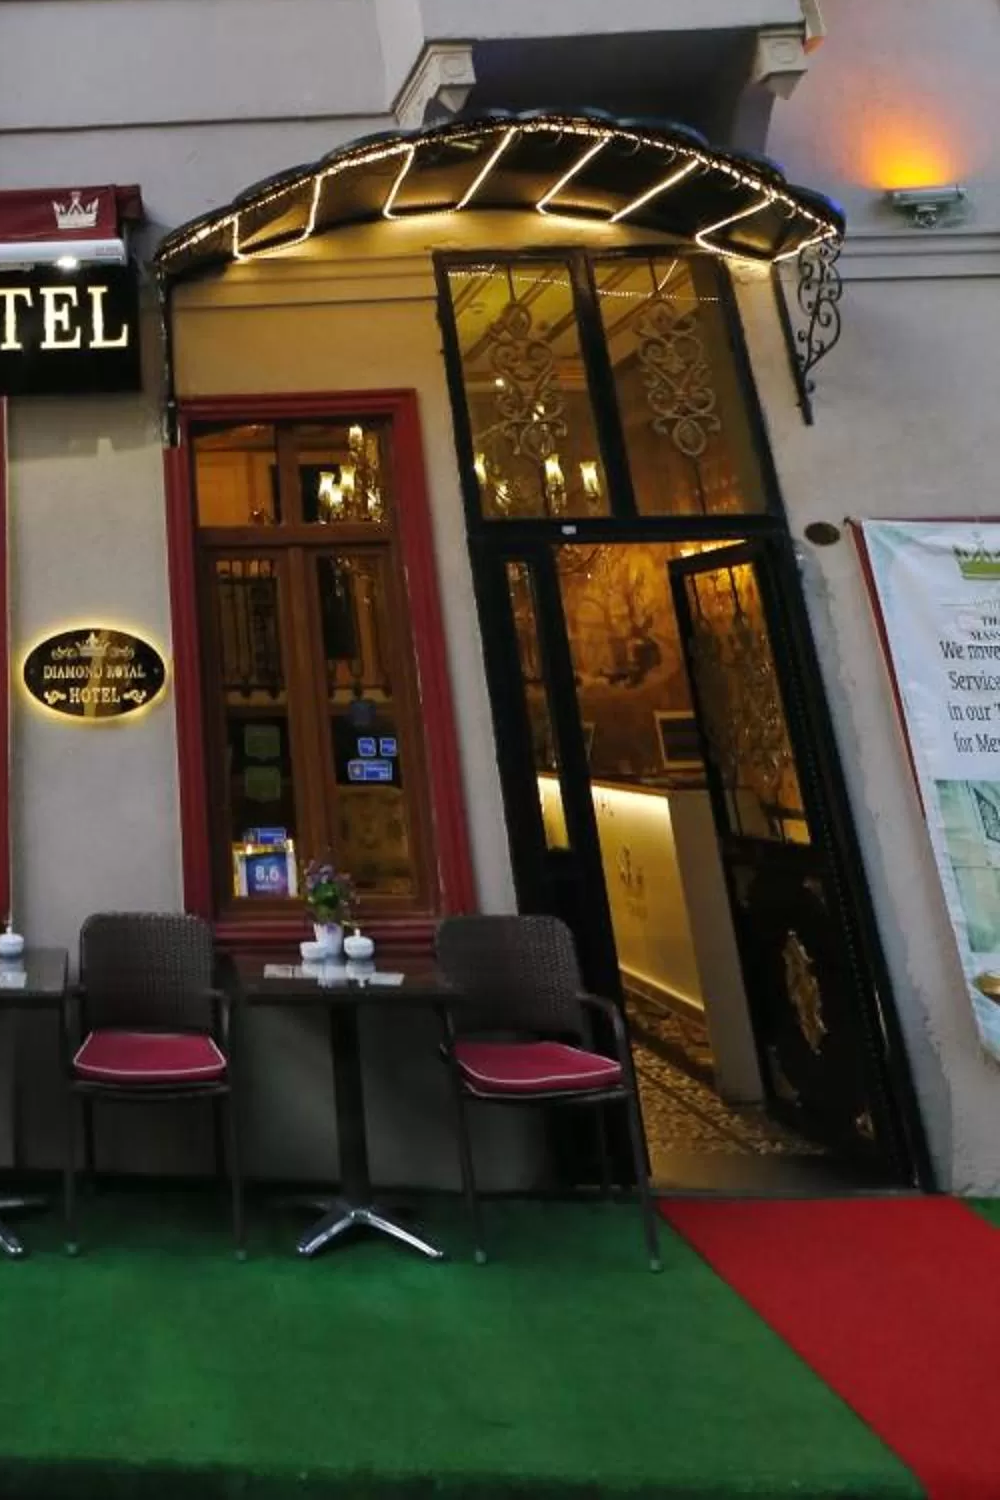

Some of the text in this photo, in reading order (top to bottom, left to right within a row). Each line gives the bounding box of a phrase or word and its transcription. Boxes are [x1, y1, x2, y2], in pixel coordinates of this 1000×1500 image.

[43, 663, 147, 680] DIAMOND ROYAL
[69, 687, 121, 704] HOTEL
[965, 704, 991, 721] our
